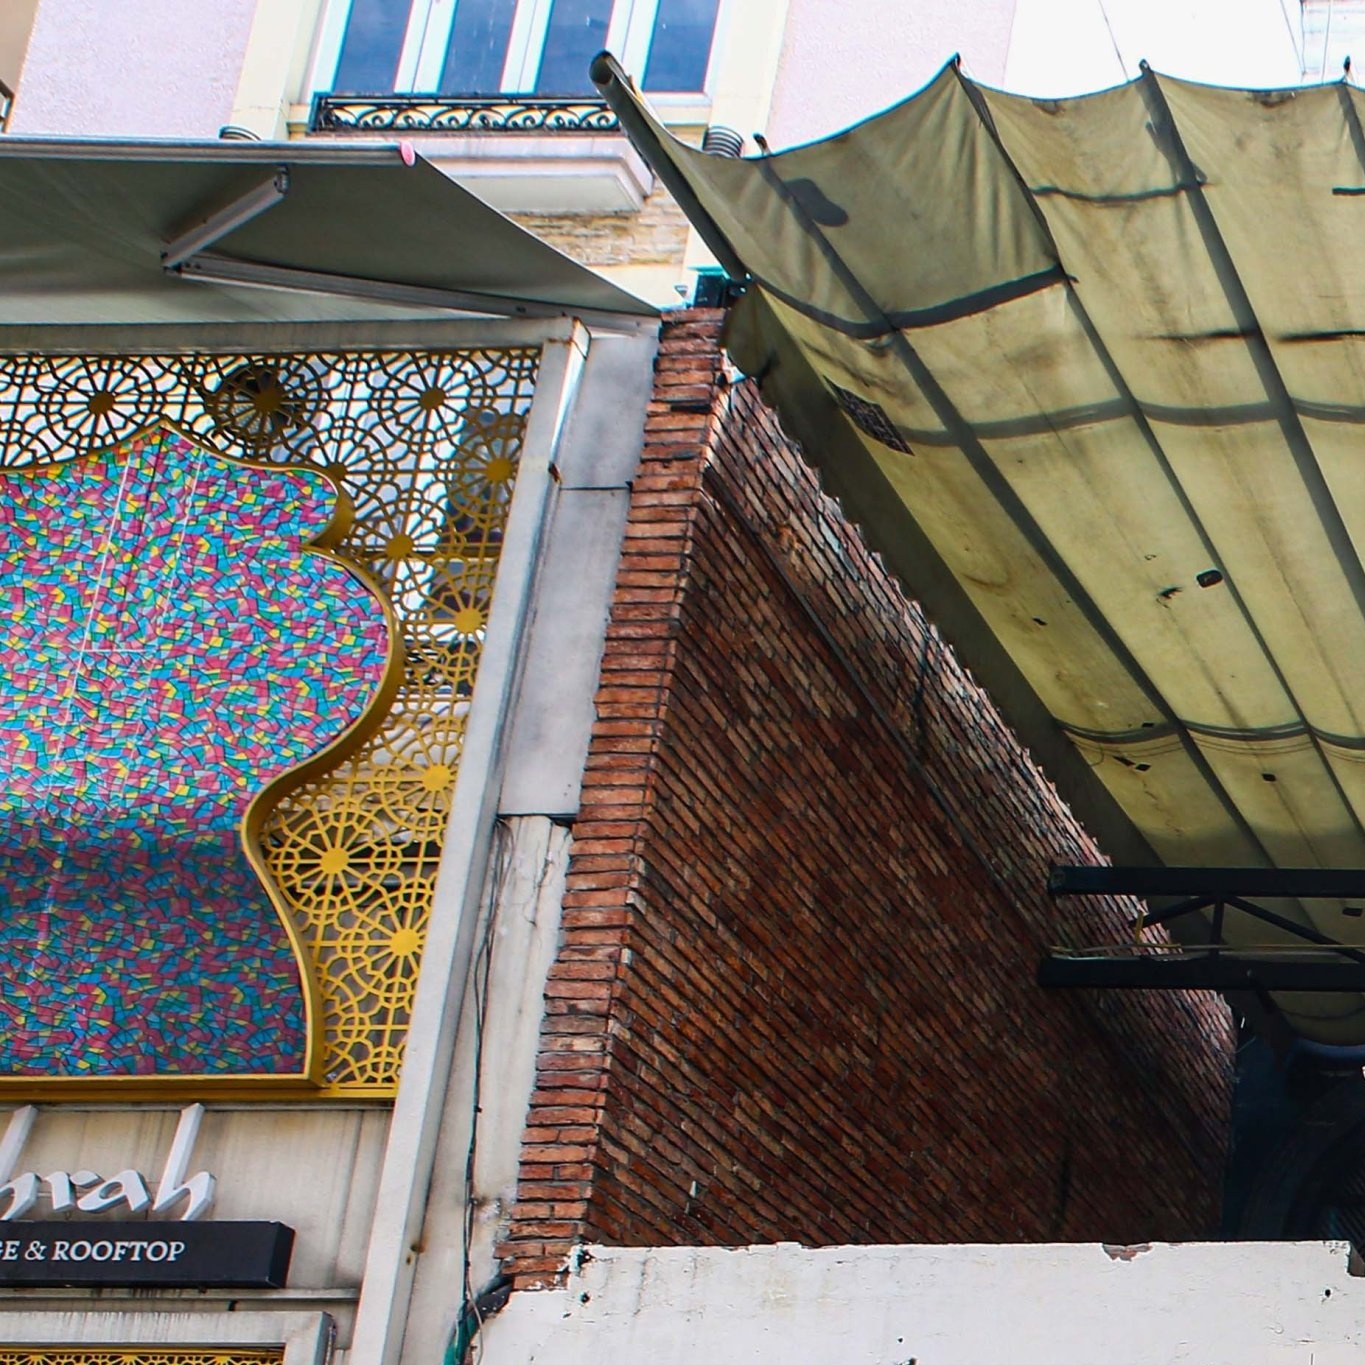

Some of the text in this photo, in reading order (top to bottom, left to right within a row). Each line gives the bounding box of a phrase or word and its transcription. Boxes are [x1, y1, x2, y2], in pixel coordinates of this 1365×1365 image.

[0, 1240, 185, 1262] E & ROOFTOP
